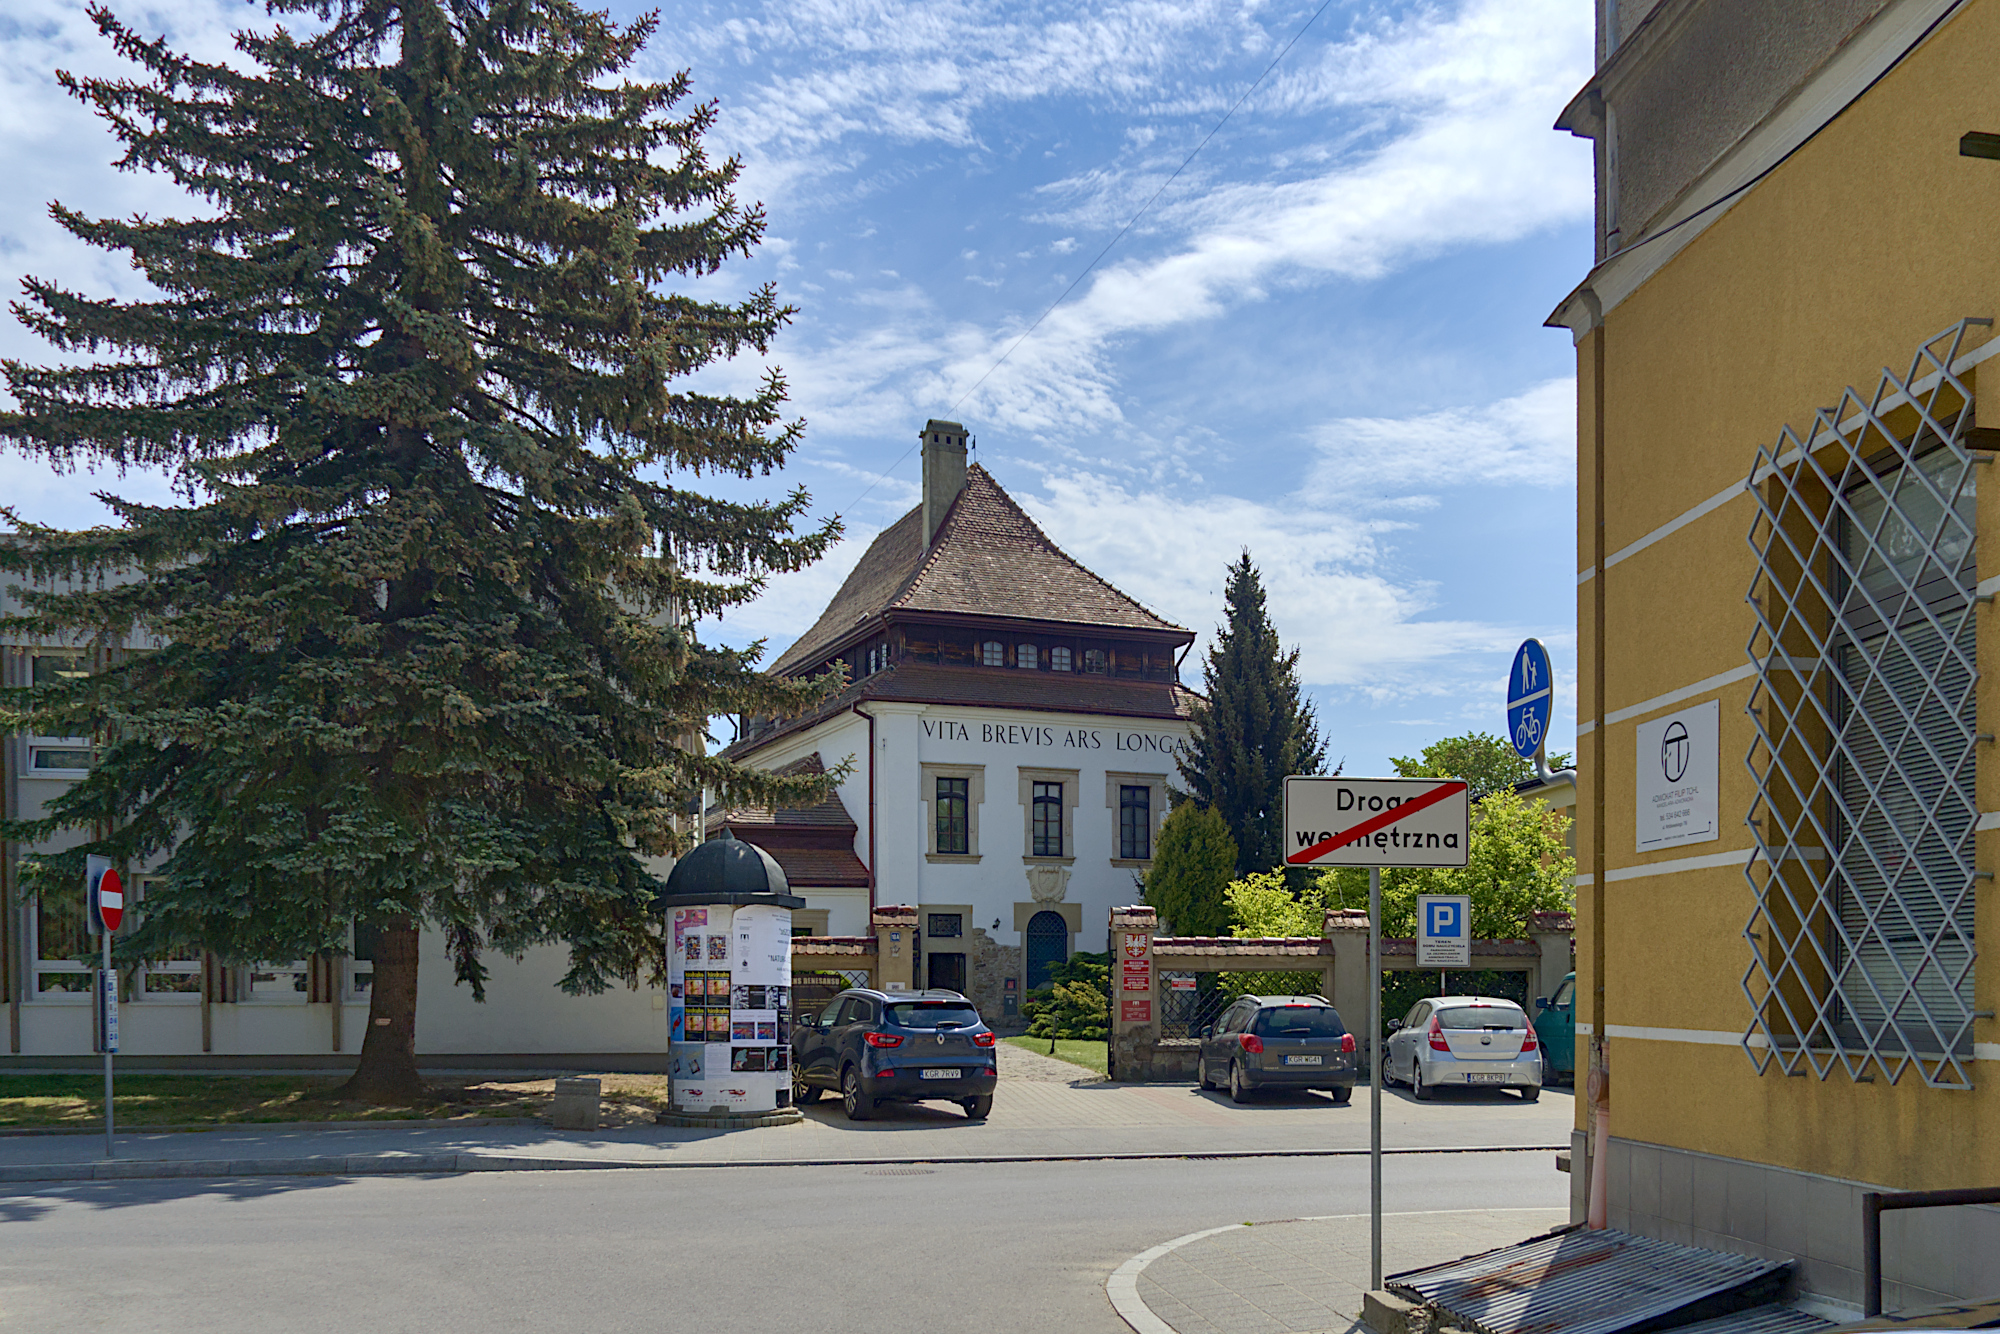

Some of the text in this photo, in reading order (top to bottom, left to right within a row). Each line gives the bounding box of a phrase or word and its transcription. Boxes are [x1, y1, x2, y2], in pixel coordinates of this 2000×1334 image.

[922, 720, 1186, 754] VITA BREVIS ARS LONGA
[1652, 790, 1674, 803] ADWOKAT
[1433, 905, 1454, 934] P
